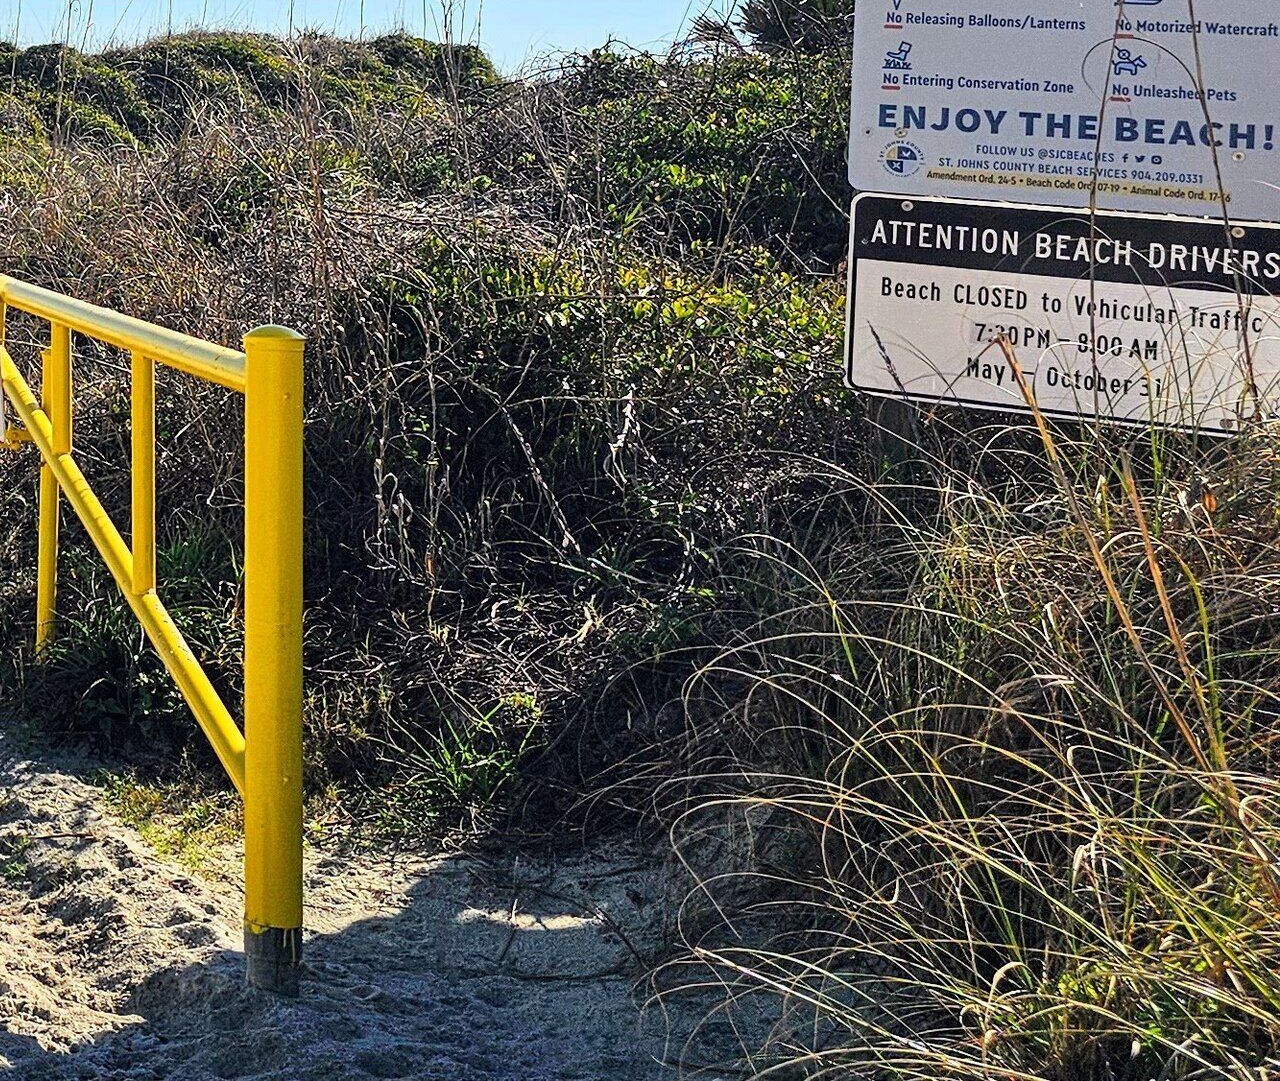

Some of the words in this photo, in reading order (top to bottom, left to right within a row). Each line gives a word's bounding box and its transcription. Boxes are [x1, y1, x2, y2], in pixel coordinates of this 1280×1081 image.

[886, 12, 902, 24] No
[906, 12, 964, 28] Releasing
[968, 14, 1086, 30] Balloons/Lanterns
[1117, 20, 1132, 32] No
[1137, 20, 1201, 33] Motorized
[1205, 22, 1279, 37] Watercraft
[883, 73, 899, 85] No
[903, 73, 953, 90] Entering
[958, 77, 1040, 91] Conservation
[1043, 80, 1074, 93] Zone
[1113, 84, 1129, 96] No
[1134, 85, 1203, 100] Unleashed
[1207, 88, 1237, 101] Pets
[878, 104, 1008, 135] ENJOY
[1019, 111, 1098, 140] THE
[1115, 116, 1274, 151] BEACH!
[976, 144, 1017, 157] FOLLOW
[1020, 147, 1034, 158] US
[1038, 148, 1115, 163] @SJCBEACHES
[939, 157, 954, 168] ST.
[957, 159, 990, 170] JOHNS
[993, 161, 1035, 172] COUNTY
[1038, 164, 1072, 175] BEACH
[1077, 166, 1127, 179] SERVICES
[1131, 169, 1203, 184] 904.209.0331
[926, 170, 977, 183] Amendment
[978, 174, 996, 184] Ord.
[1026, 177, 1052, 188] Beach
[1054, 179, 1075, 190] Code
[1077, 181, 1095, 190] Ord
[1097, 182, 1120, 192] 07-19
[1130, 185, 1161, 197] Animal
[1163, 188, 1185, 199] Code
[1188, 190, 1206, 201] Ord.
[1209, 192, 1231, 203] 17-6
[871, 218, 1019, 257] ATTENTION
[1035, 232, 1131, 266] BEACH
[1148, 242, 1280, 279] DRIVERS
[881, 276, 941, 302] Beach
[953, 283, 1028, 310] CLOSED
[1041, 291, 1062, 314] to
[1074, 294, 1177, 325] Vehicular
[1189, 305, 1263, 333] Traffc
[1128, 338, 1157, 360] AM
[967, 357, 1005, 386] May
[1046, 366, 1132, 394] October
[1139, 376, 1161, 398] 31
